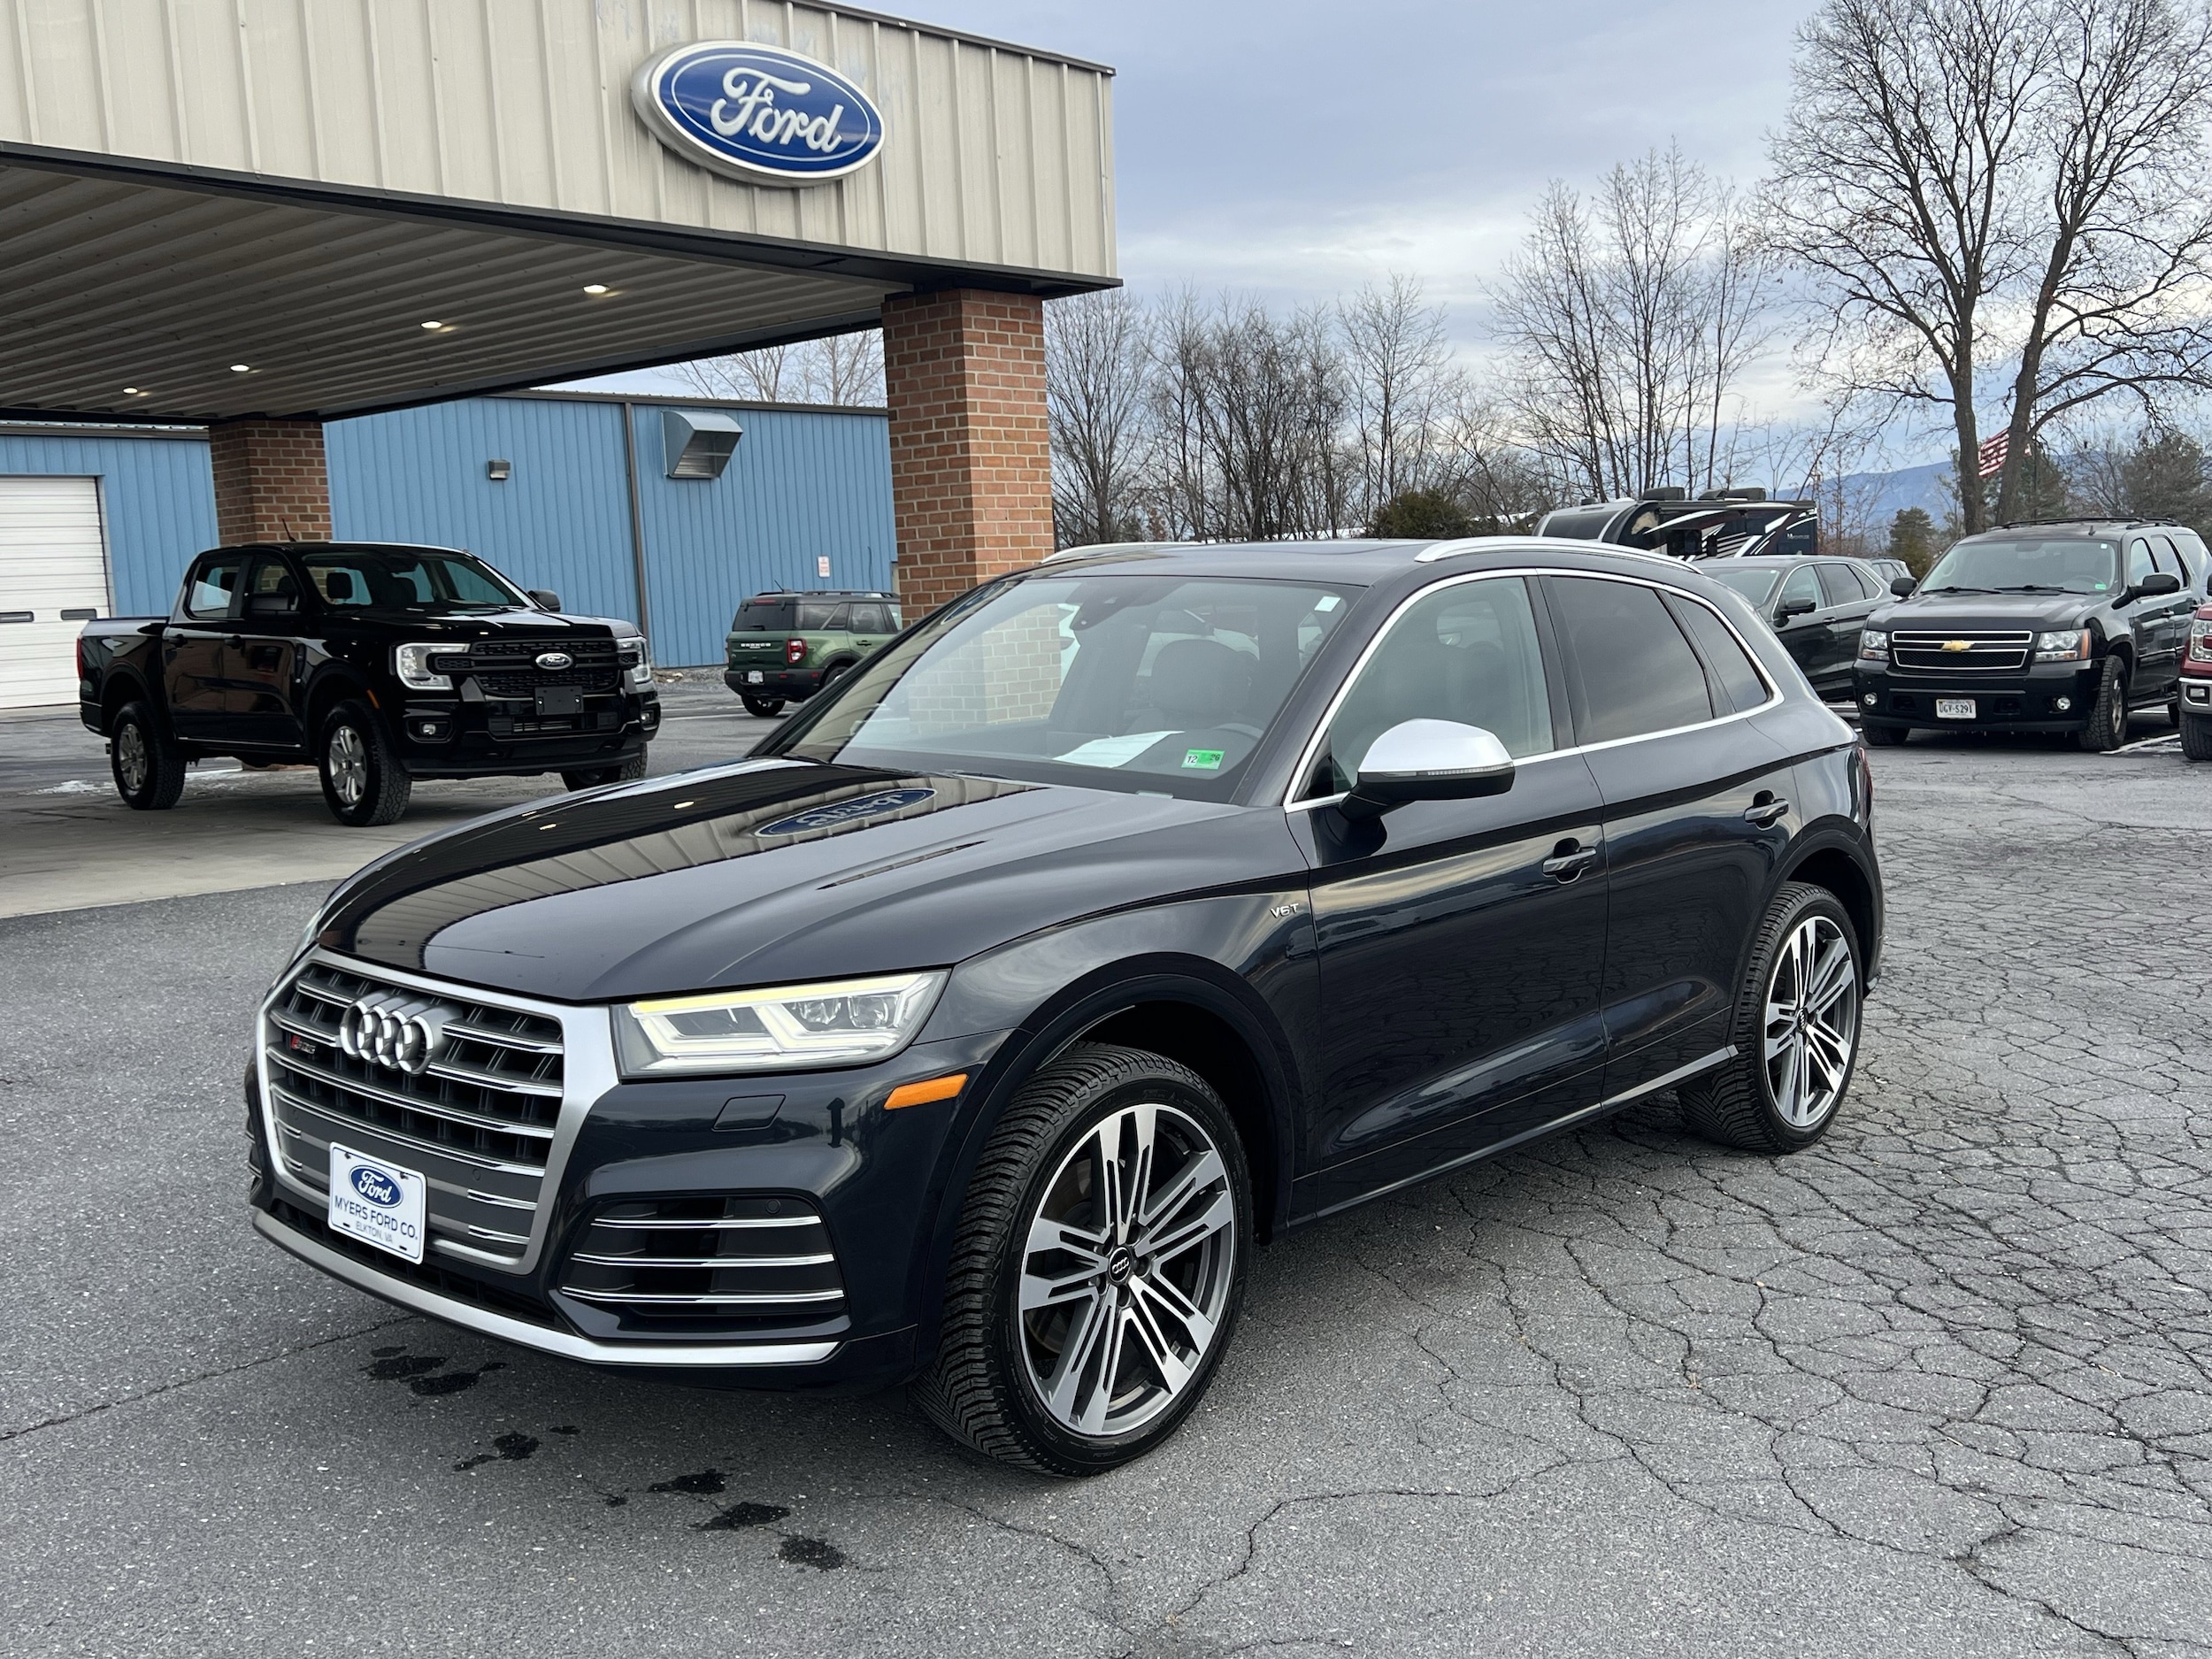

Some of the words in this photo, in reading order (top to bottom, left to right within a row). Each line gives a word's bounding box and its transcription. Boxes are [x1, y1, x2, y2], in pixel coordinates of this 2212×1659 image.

[710, 66, 844, 153] Ford
[1187, 755, 1198, 764] 12
[1270, 902, 1299, 918] V6T
[357, 1170, 393, 1203] Ford
[334, 1194, 368, 1220] MYERS
[370, 1210, 398, 1232] FORD
[400, 1222, 418, 1240] CO.
